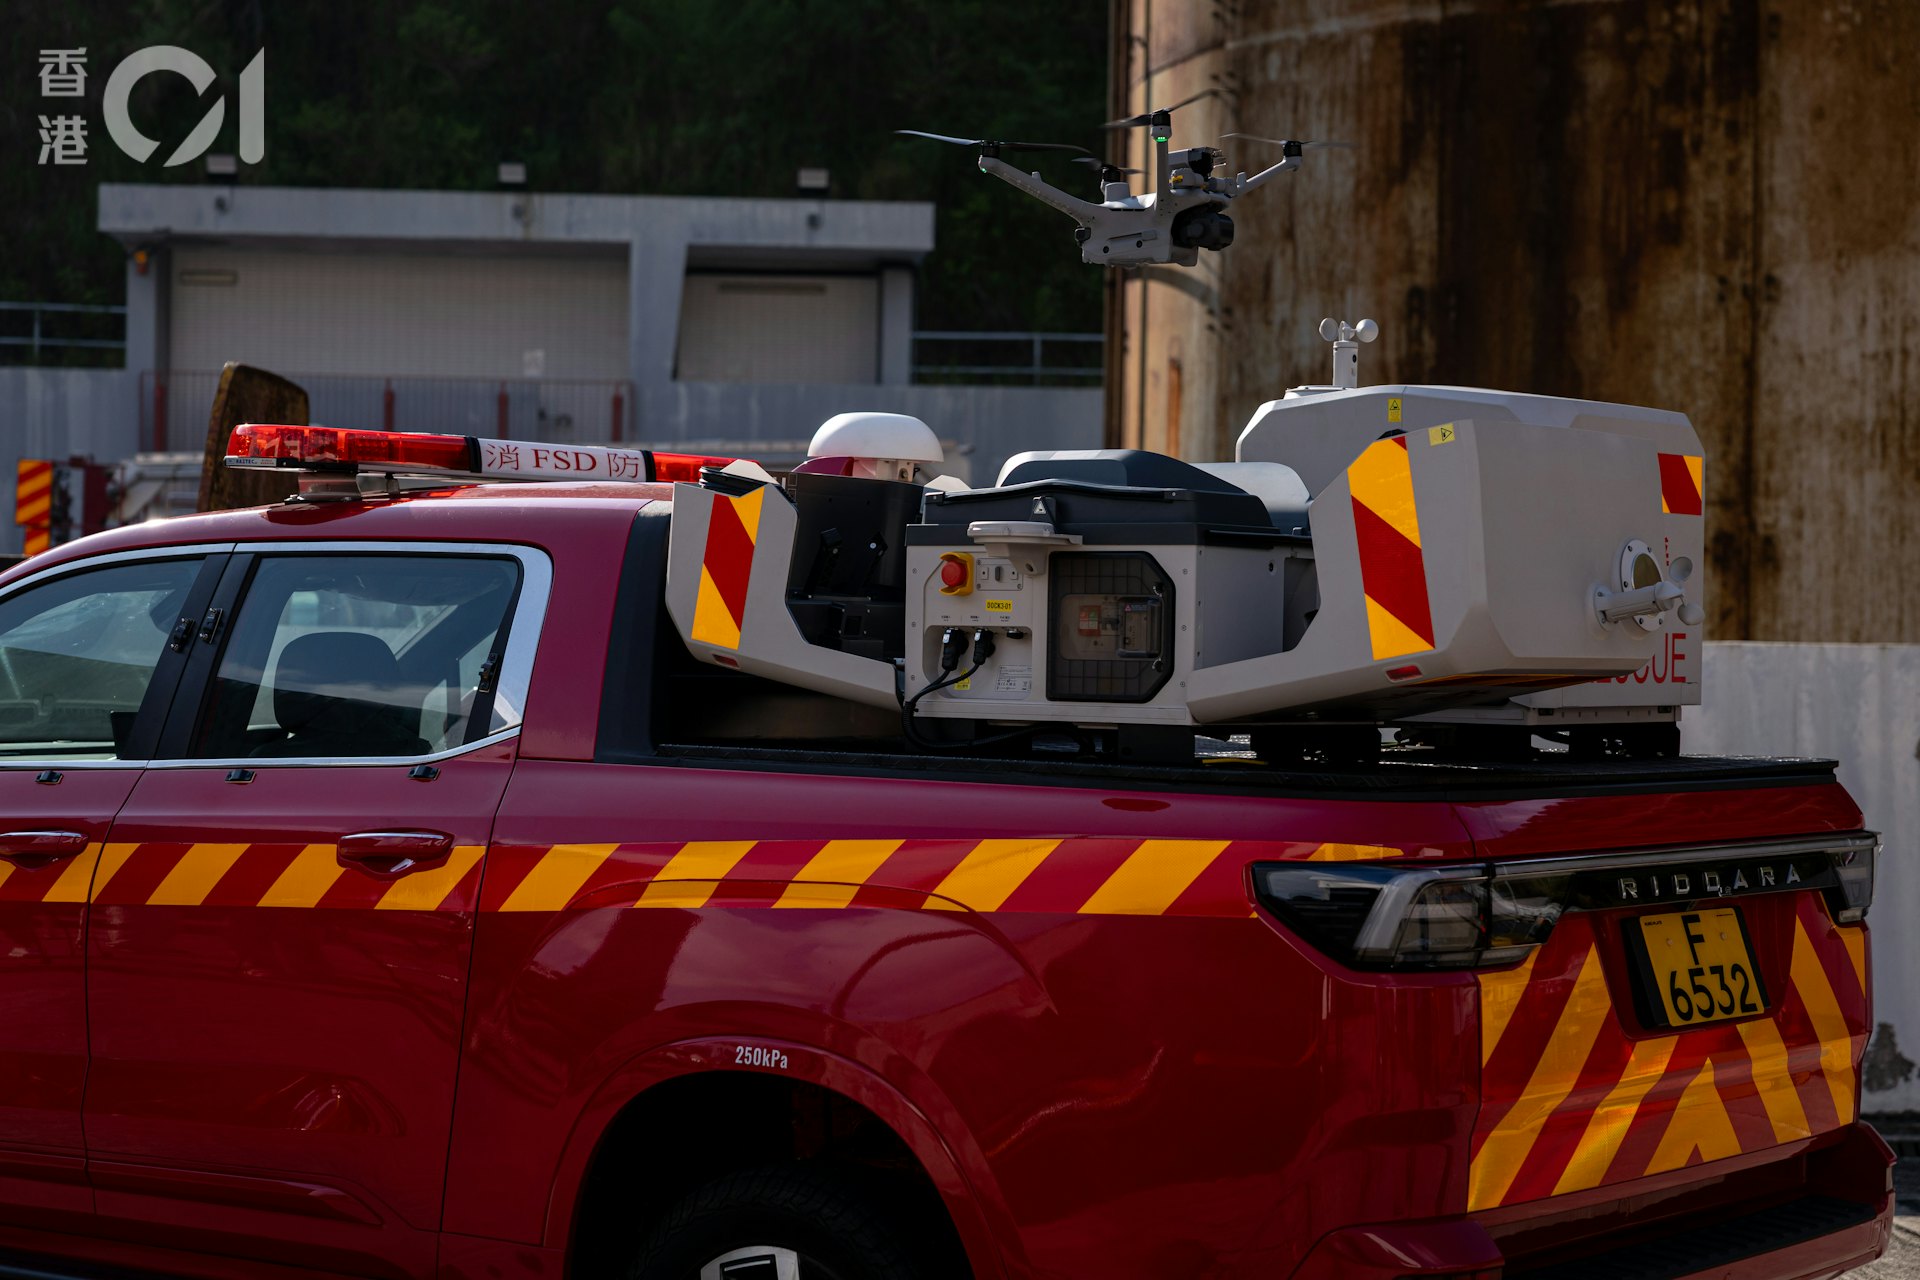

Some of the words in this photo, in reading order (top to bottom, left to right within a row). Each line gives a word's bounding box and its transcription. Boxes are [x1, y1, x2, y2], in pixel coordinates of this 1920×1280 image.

[486, 444, 519, 471] 消
[531, 449, 597, 472] FSD
[607, 451, 640, 478] 防
[986, 601, 1012, 610] DOCK3-01
[1618, 864, 1801, 899] RIDDARA
[1681, 914, 1704, 965] F
[1669, 963, 1758, 1021] 6532
[735, 1046, 788, 1069] 250kPa
